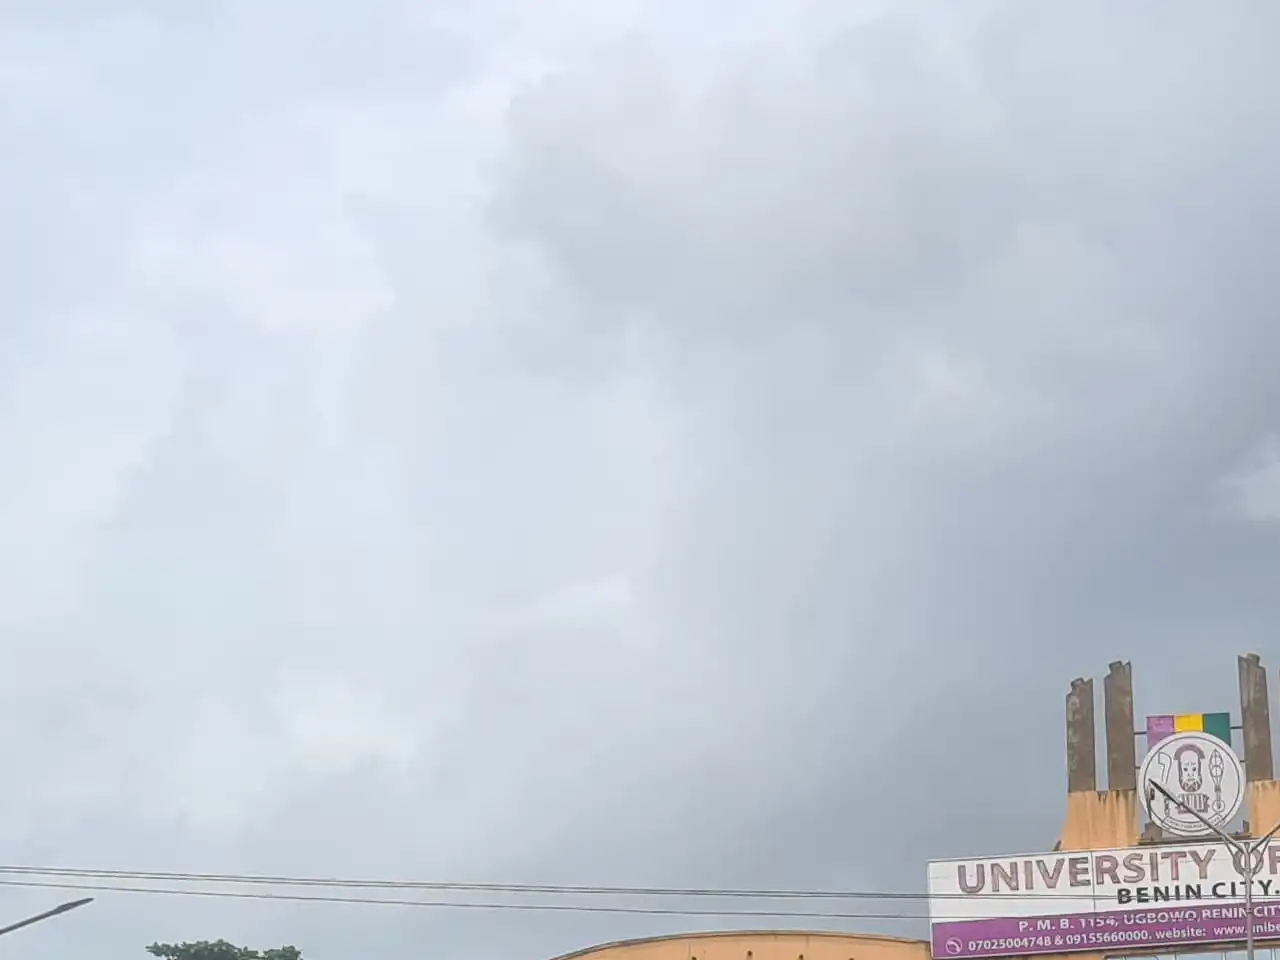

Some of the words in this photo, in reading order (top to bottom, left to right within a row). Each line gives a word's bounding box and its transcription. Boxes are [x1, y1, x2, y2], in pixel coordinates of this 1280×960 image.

[957, 849, 1216, 894] UNIVERSITY
[1117, 884, 1202, 905] BENIN
[1054, 934, 1064, 946] &
[1155, 925, 1206, 940] website:
